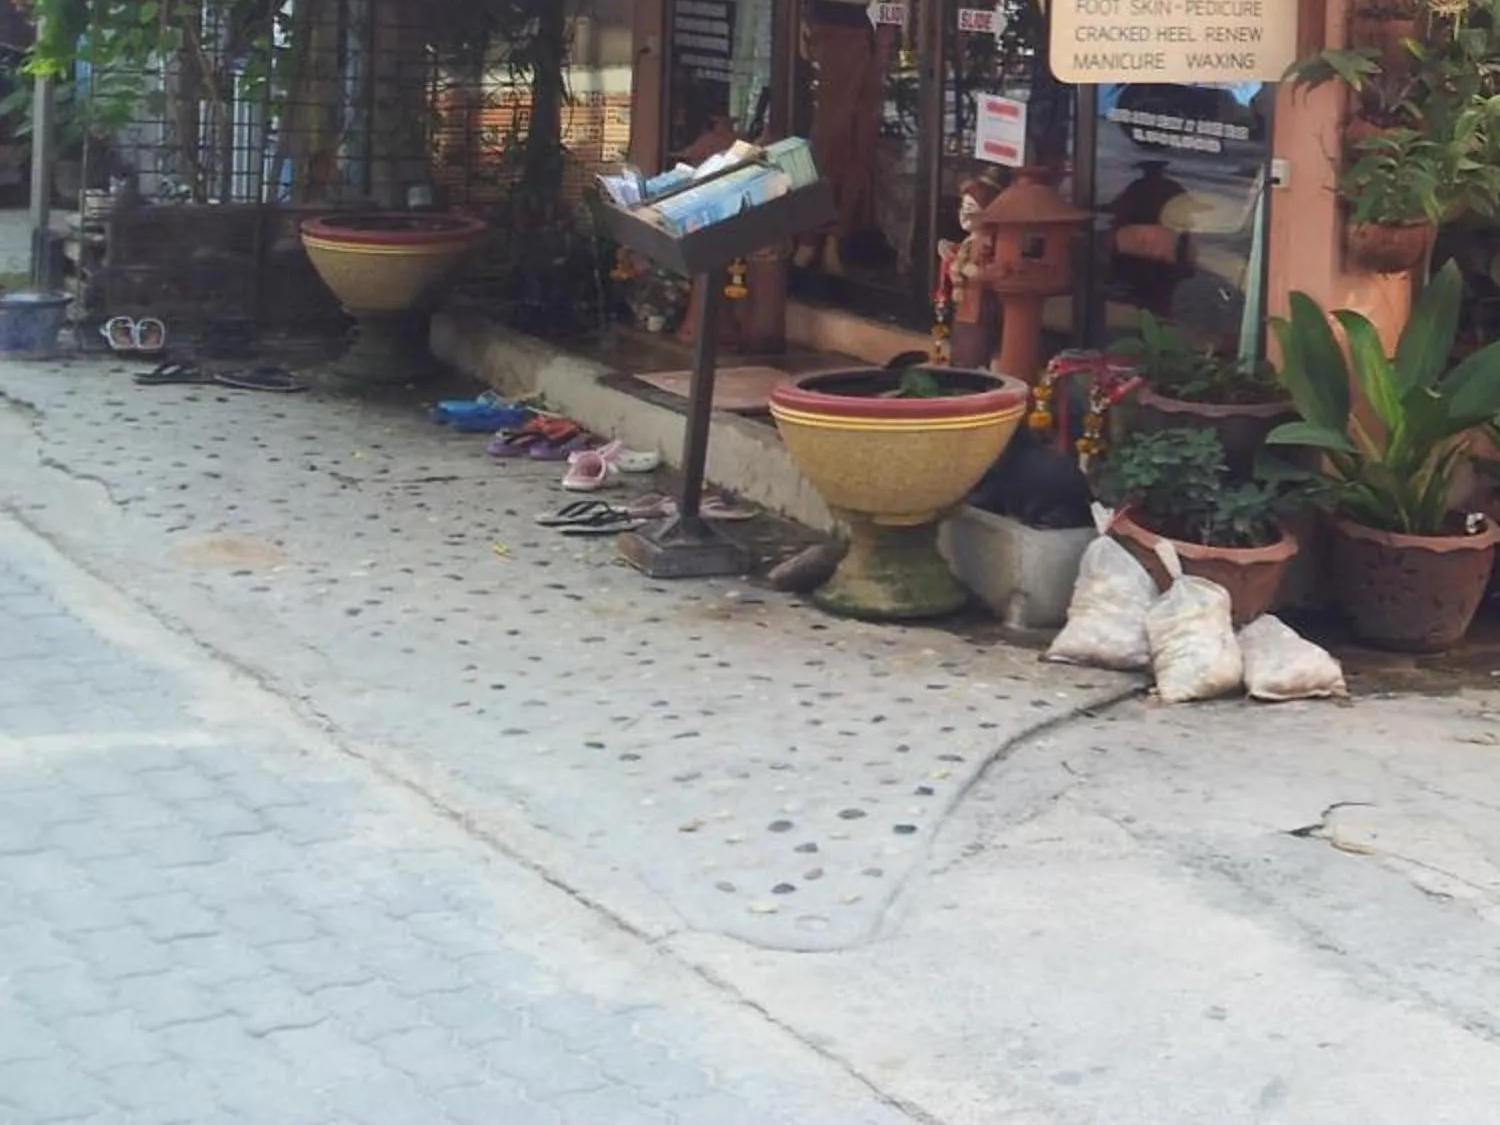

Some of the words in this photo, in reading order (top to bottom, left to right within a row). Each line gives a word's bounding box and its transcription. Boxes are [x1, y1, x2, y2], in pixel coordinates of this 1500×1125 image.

[1075, 26, 1150, 43] CRACKED
[1157, 27, 1198, 43] HEEL
[1205, 27, 1264, 43] RENEW
[1073, 53, 1166, 71] MANICURE
[1186, 53, 1256, 71] WAXING
